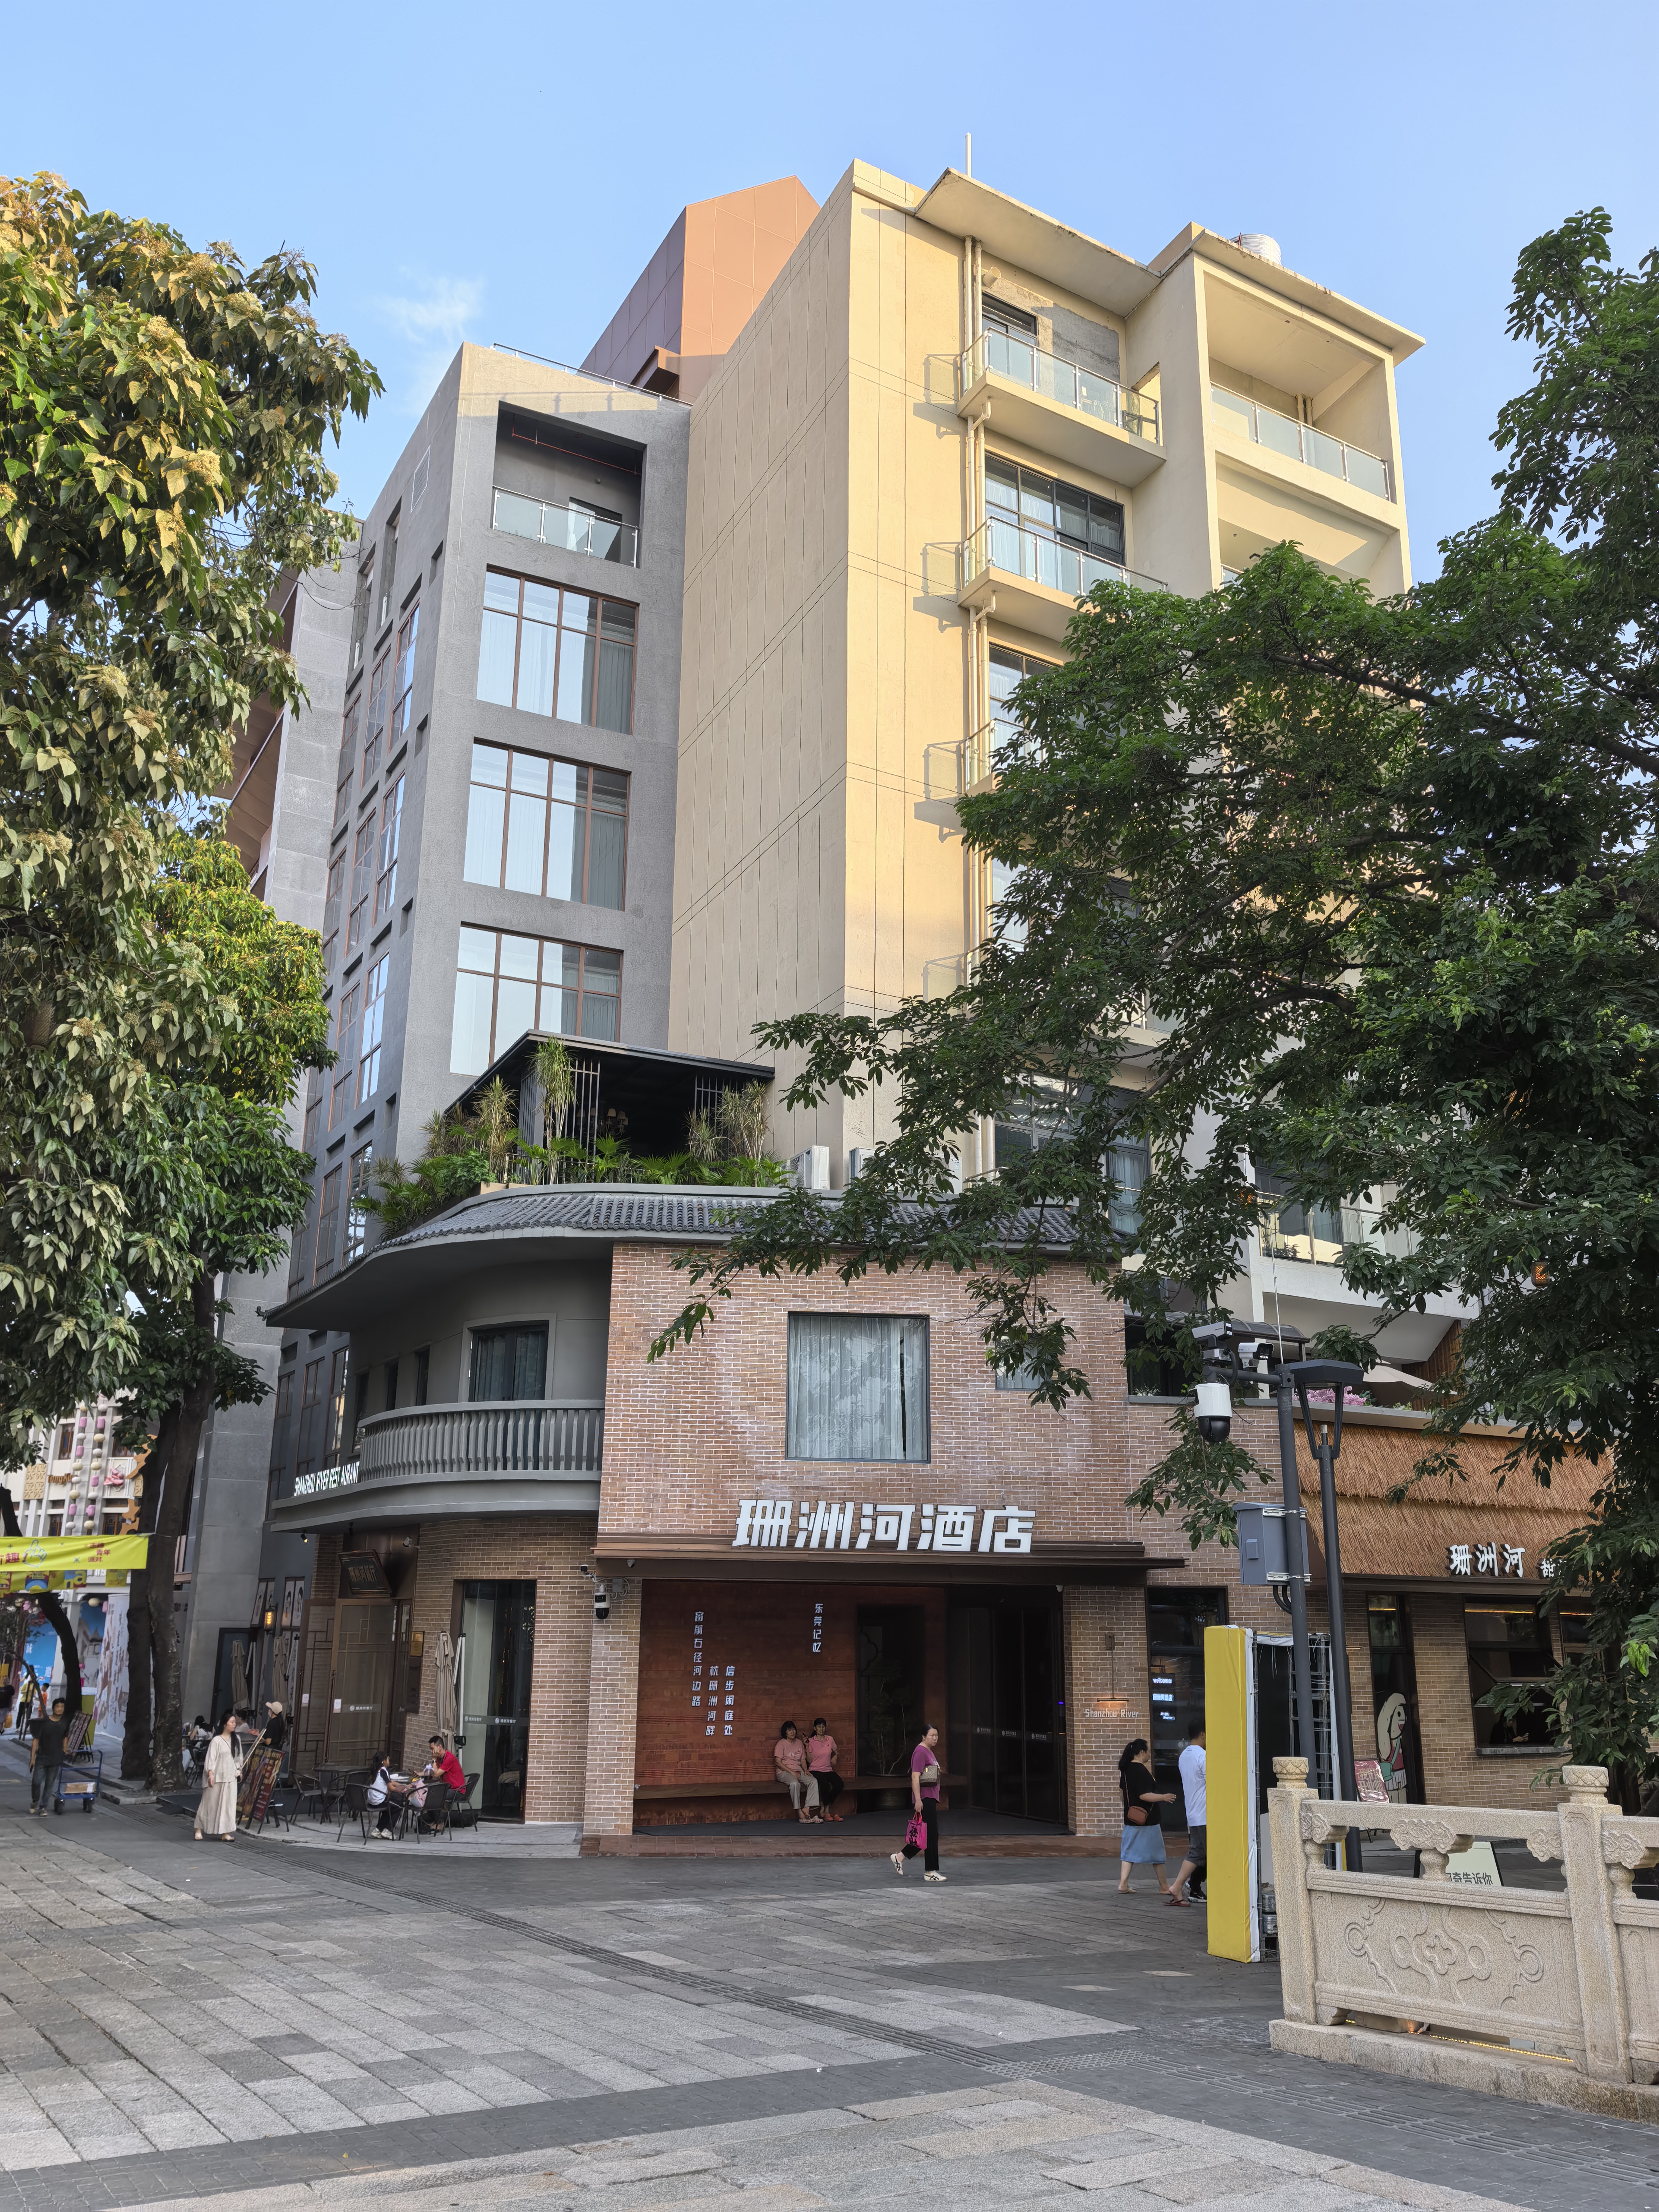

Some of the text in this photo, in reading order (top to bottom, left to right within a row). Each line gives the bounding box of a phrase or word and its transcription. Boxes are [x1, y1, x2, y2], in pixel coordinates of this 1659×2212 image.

[294, 1473, 316, 1496] SHANZHOU
[316, 1469, 330, 1492] RIVER
[732, 1499, 1036, 1553] 珊洲河酒店
[1450, 1542, 1526, 1578] 珊洲河
[812, 1603, 823, 1652] 东莞记忆
[691, 1611, 704, 1706] 窗前石径河边路
[705, 1665, 719, 1736] 枕珊洲河畔
[724, 1665, 735, 1736] 信步闲庭处
[1085, 1708, 1139, 1718] Shanzhou River
